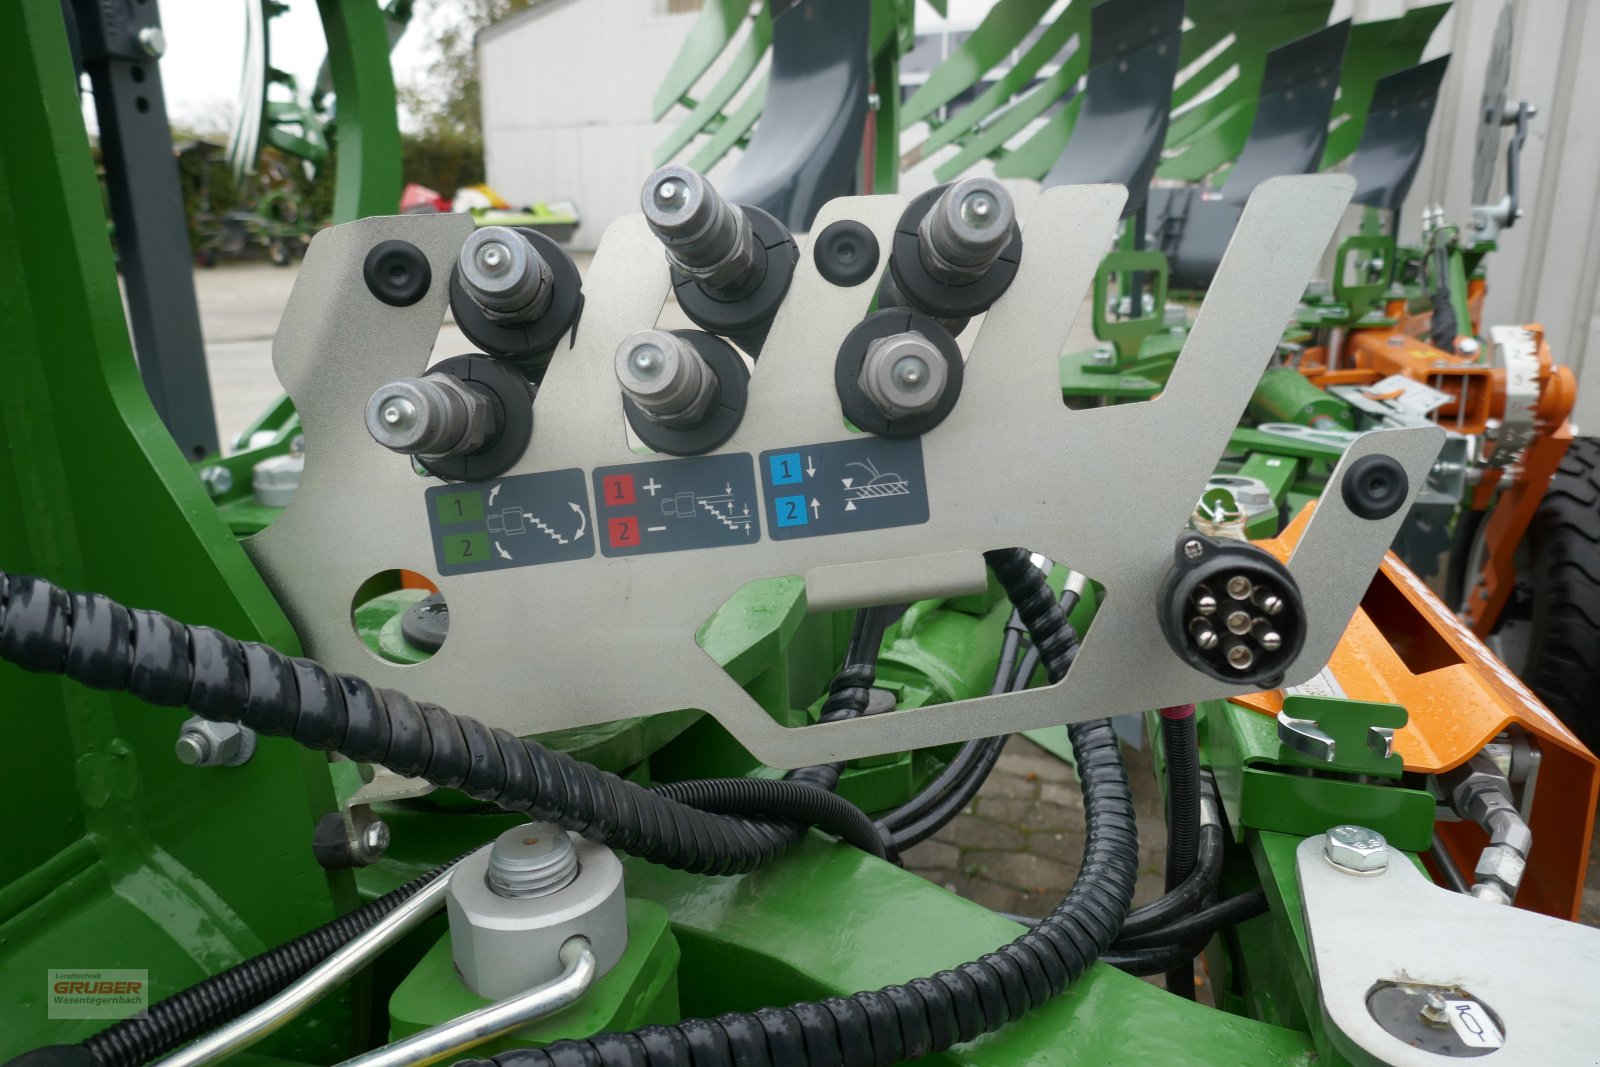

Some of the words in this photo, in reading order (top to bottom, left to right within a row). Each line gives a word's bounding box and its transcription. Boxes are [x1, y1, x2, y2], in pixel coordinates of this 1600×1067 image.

[780, 460, 793, 479] 1
[613, 480, 626, 500] 1
[453, 499, 464, 517] 1
[785, 501, 798, 520] 2
[618, 522, 631, 541] 2
[460, 539, 473, 557] 2
